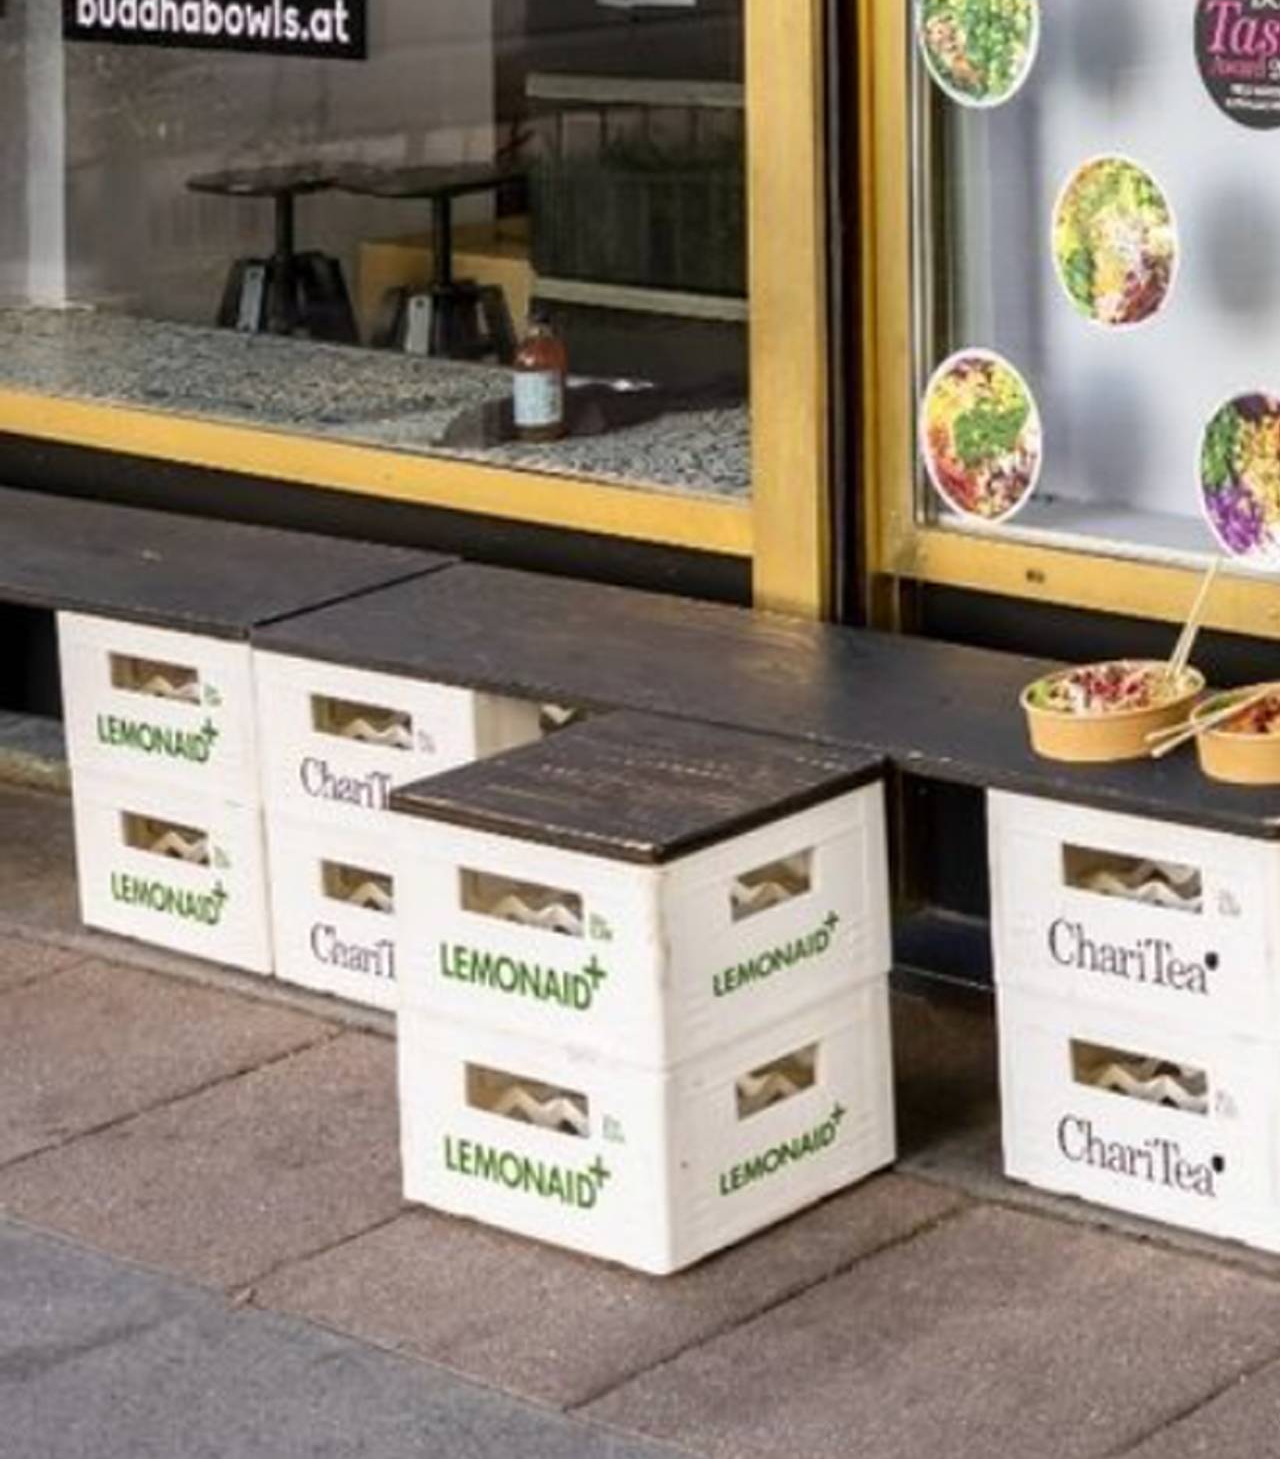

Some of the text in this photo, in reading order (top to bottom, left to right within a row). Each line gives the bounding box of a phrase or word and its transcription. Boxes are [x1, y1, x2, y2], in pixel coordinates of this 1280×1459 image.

[300, 757, 392, 812] ChariT
[1048, 918, 1210, 996] ChariTea
[1057, 1114, 1217, 1198] ChariTea
